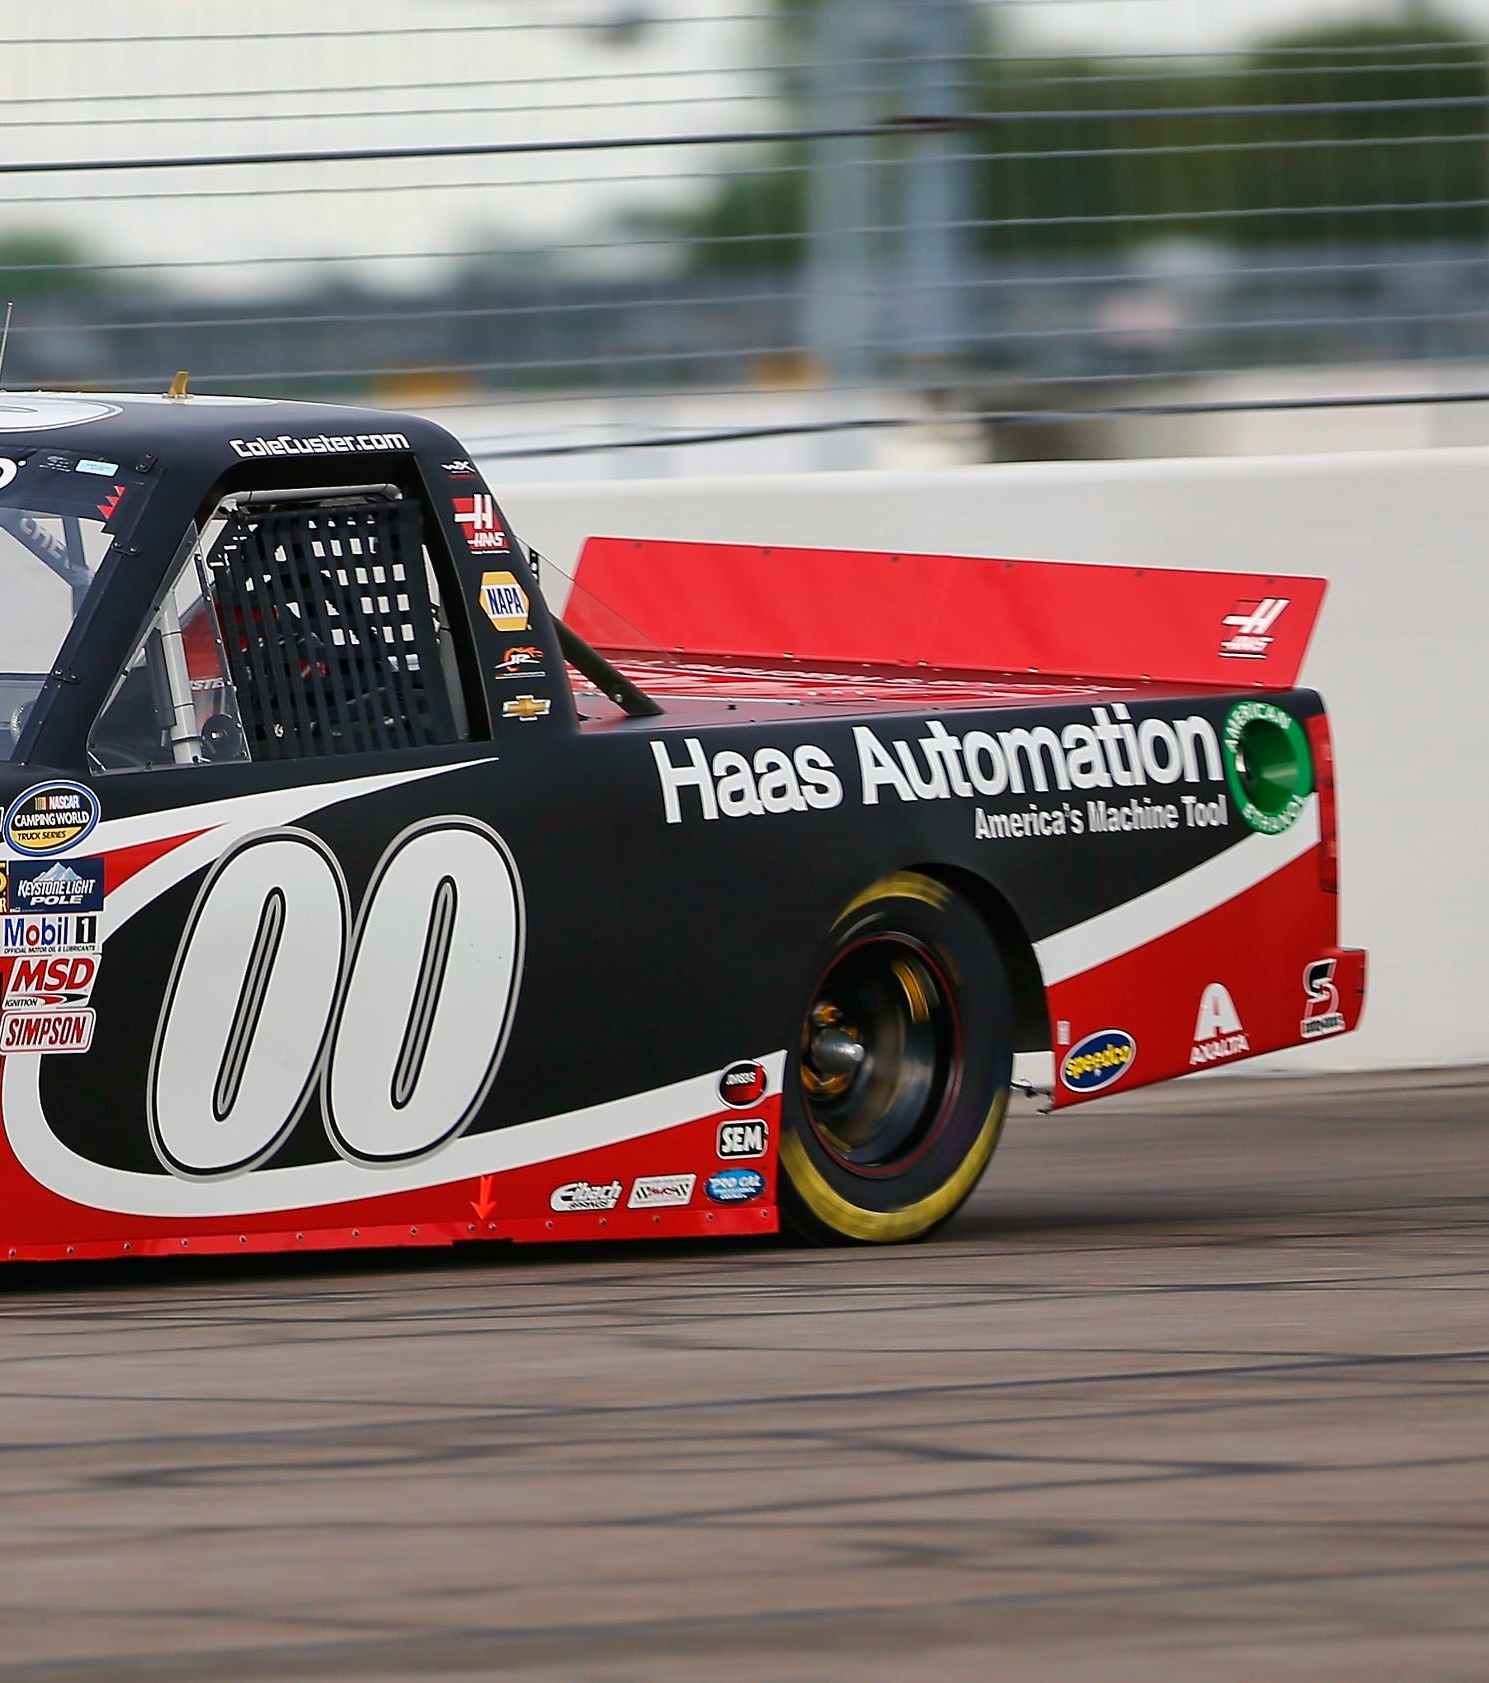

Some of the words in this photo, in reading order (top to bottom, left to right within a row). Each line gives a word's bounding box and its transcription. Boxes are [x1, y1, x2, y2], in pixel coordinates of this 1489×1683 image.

[229, 432, 410, 458] ColeCuster.com
[486, 587, 524, 615] NAPA
[649, 738, 843, 824] Haas
[851, 702, 1225, 805] Automation
[48, 795, 81, 810] NASCAR
[974, 802, 1085, 839] America's
[1086, 797, 1179, 832] Machine
[1180, 794, 1229, 827] Tool
[14, 812, 56, 828] CAMPING
[56, 810, 90, 825] WORLD
[17, 832, 41, 841] TRUCK
[42, 831, 67, 839] SERIES
[17, 880, 66, 897] KEYSTONE
[65, 879, 96, 896] LIGHT
[30, 894, 84, 906] POLE
[4, 916, 69, 947] Mobil
[63, 945, 96, 953] LUBRICANTS
[11, 958, 95, 993] MSD
[5, 998, 38, 1007] IGNITION
[146, 814, 528, 1184] 00
[6, 1016, 87, 1046] SIMPSON
[1189, 1034, 1250, 1065] AXALTA
[721, 1125, 763, 1153] SEM
